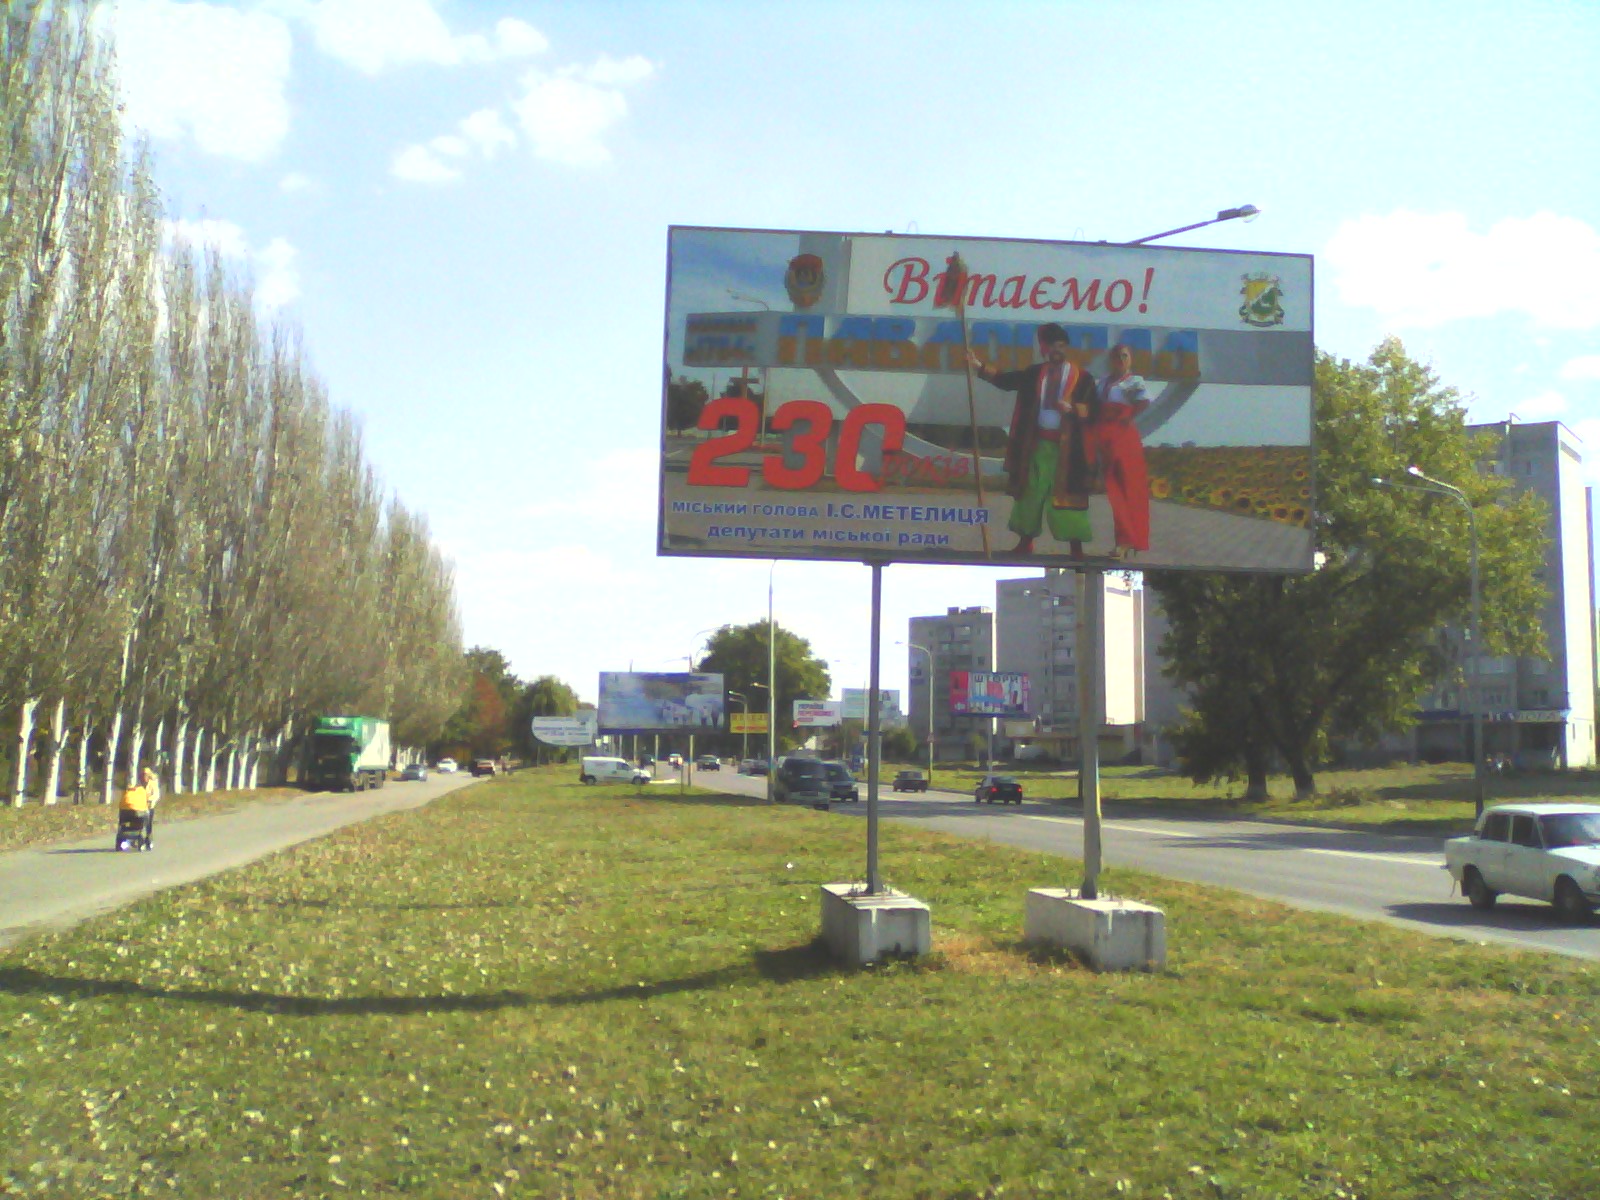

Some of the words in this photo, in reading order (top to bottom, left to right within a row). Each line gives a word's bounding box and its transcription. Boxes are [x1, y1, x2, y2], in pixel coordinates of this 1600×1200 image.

[883, 256, 1155, 313] Вітаємо!
[687, 396, 907, 492] 230
[707, 525, 804, 541] депутати
[898, 531, 950, 547] ради
